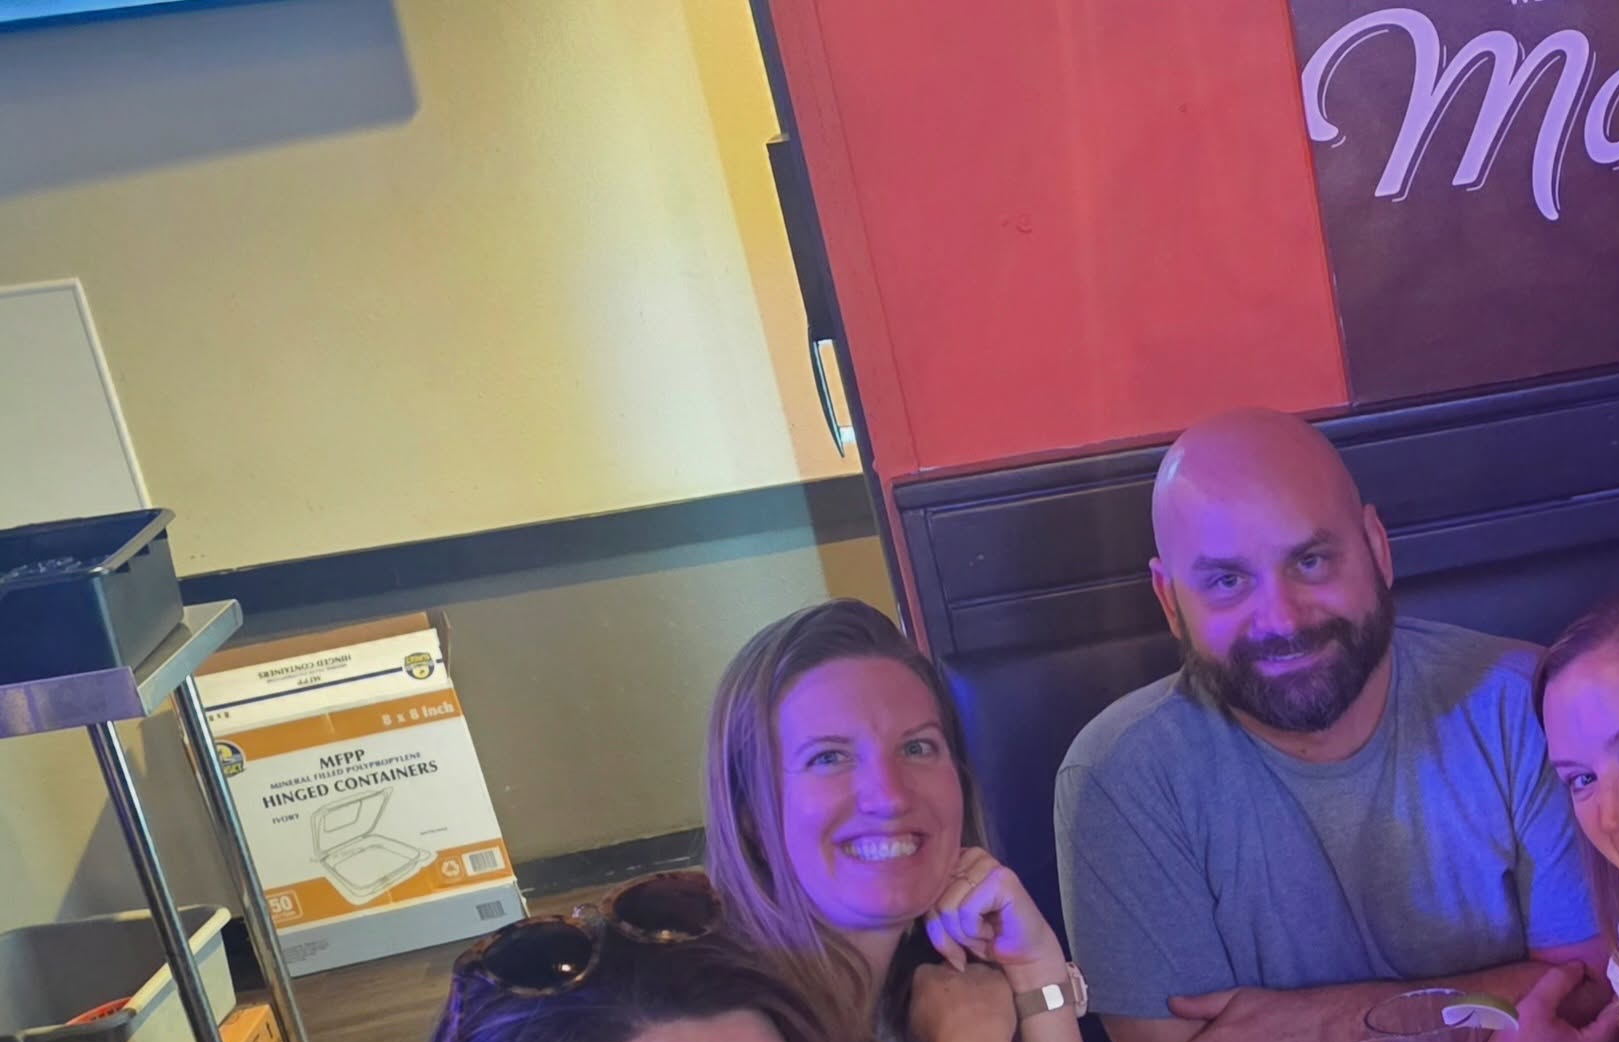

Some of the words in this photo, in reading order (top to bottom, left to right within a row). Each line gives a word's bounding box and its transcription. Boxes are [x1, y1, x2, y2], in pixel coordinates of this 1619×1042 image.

[382, 714, 392, 726] 8
[409, 708, 419, 720] 8
[421, 701, 455, 718] Inch
[270, 776, 312, 790] MINERAL
[314, 768, 344, 782] FILLED
[346, 752, 421, 774] POLYPROPYLENE
[320, 749, 366, 770] MFPP
[262, 784, 329, 809] HINGED
[334, 760, 438, 792] CONTAINERS
[272, 813, 300, 824] IVORY
[268, 895, 293, 913] 50
